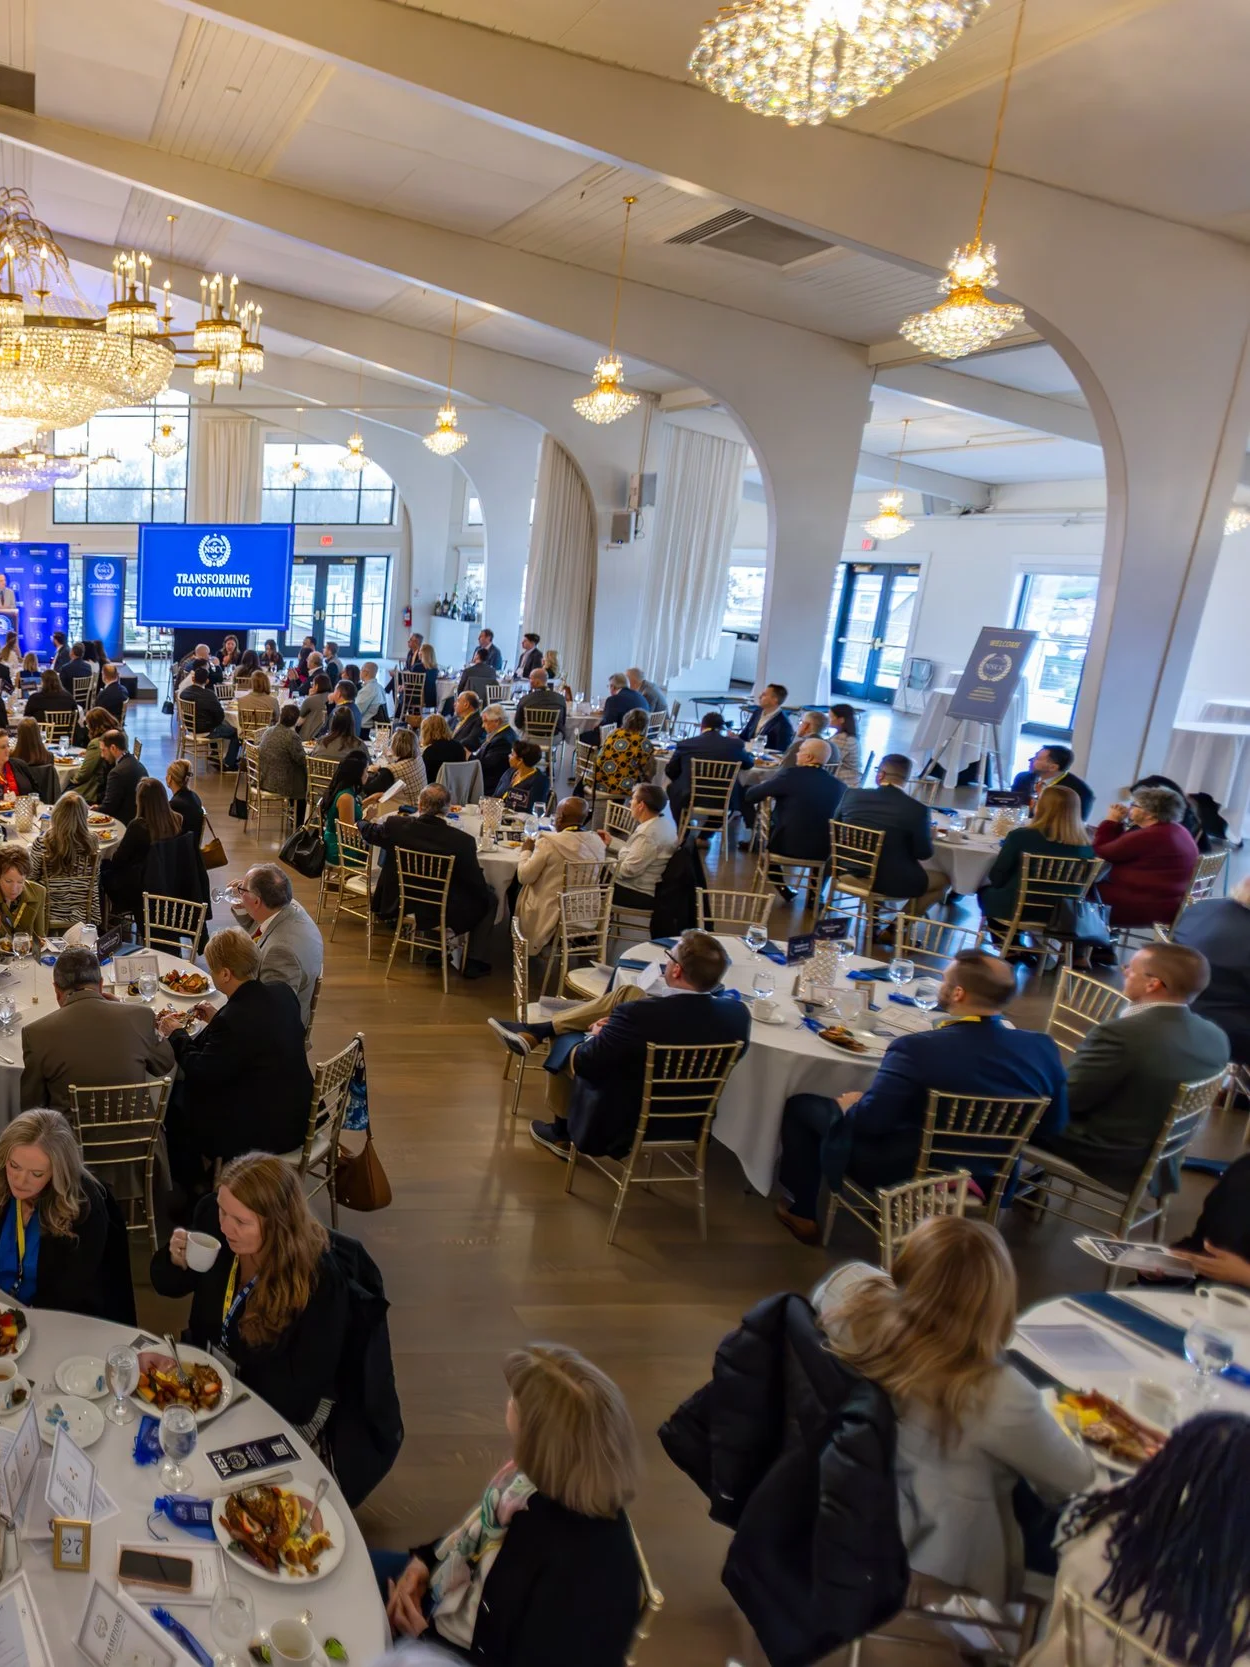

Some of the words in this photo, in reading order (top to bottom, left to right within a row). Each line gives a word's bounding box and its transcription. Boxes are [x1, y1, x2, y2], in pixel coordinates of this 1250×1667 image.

[204, 545, 225, 554] NSCC
[176, 573, 251, 585] TRANSFORMING
[173, 586, 193, 597] OUR
[195, 586, 253, 598] COMMUNITY
[212, 1454, 231, 1476] YES!
[62, 1538, 83, 1555] 27
[103, 1611, 124, 1666] CHAMPIONS
